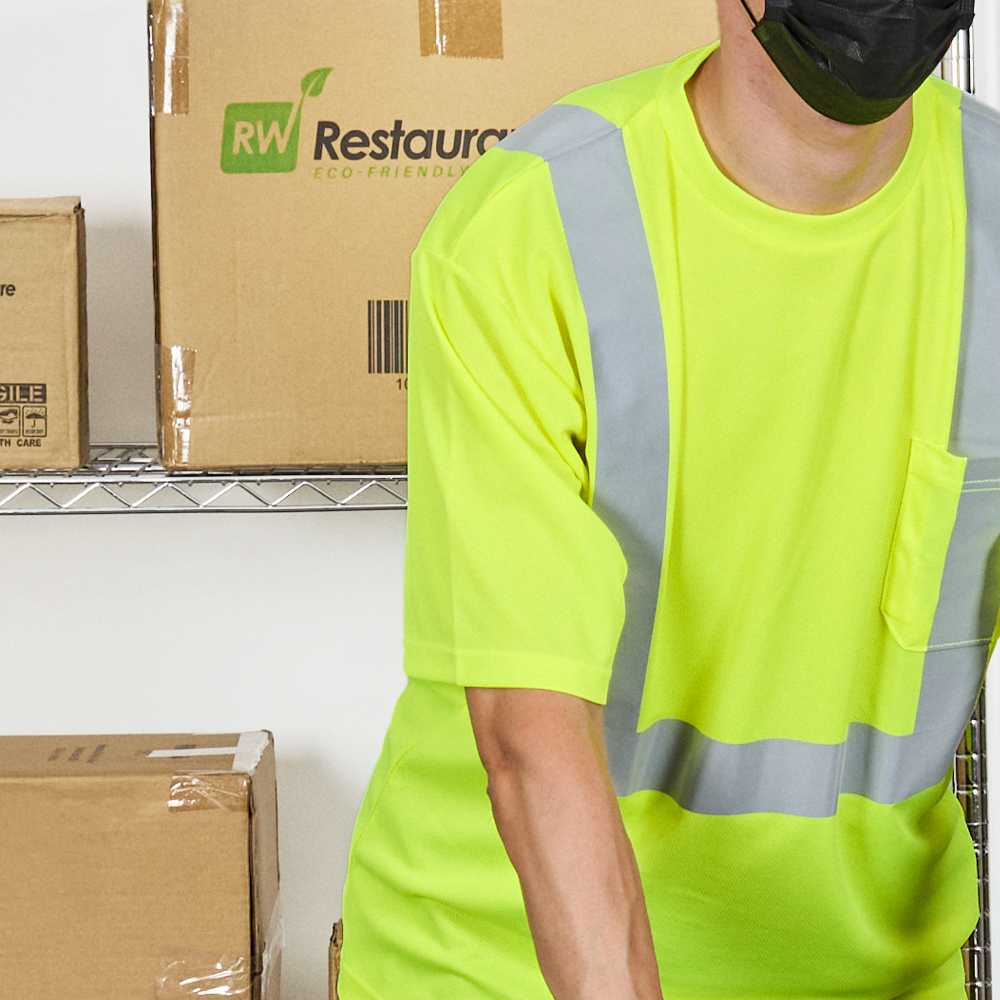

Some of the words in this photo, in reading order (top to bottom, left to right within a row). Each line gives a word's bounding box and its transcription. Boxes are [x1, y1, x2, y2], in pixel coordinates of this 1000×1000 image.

[231, 119, 298, 155] RW
[313, 119, 516, 160] Restaura
[16, 438, 42, 447] CARE
